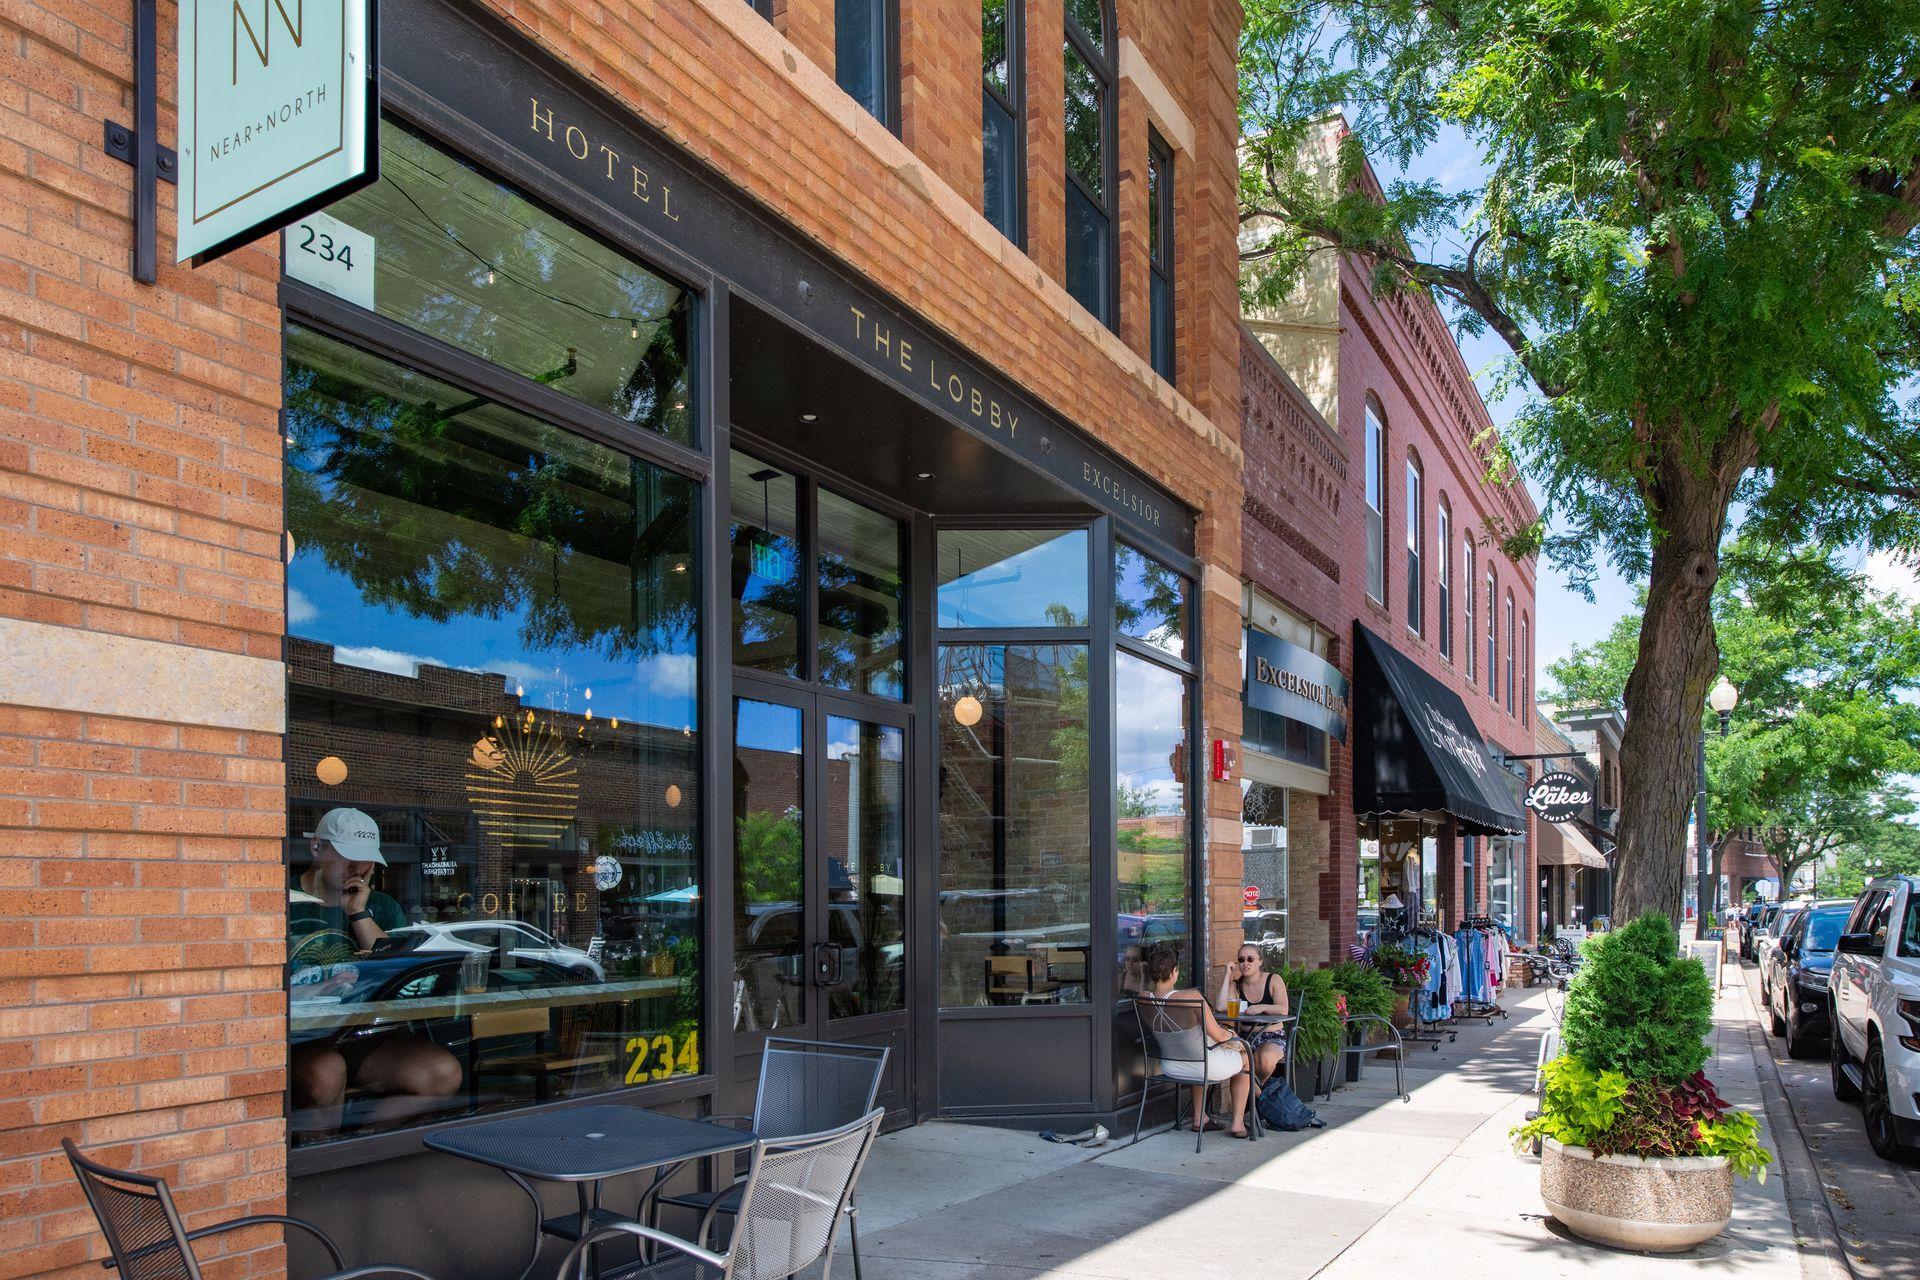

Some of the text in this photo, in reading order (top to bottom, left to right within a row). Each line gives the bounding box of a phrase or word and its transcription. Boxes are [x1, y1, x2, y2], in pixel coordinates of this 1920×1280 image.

[530, 97, 680, 222] HOTEL
[300, 224, 354, 272] 234
[851, 305, 1019, 438] THE LOBBY
[1083, 461, 1161, 528] EXCELSIOR
[1524, 784, 1592, 811] Lakes
[1542, 773, 1577, 785] RUNNING
[1539, 810, 1575, 822] COMPANY
[624, 1030, 700, 1085] 234
